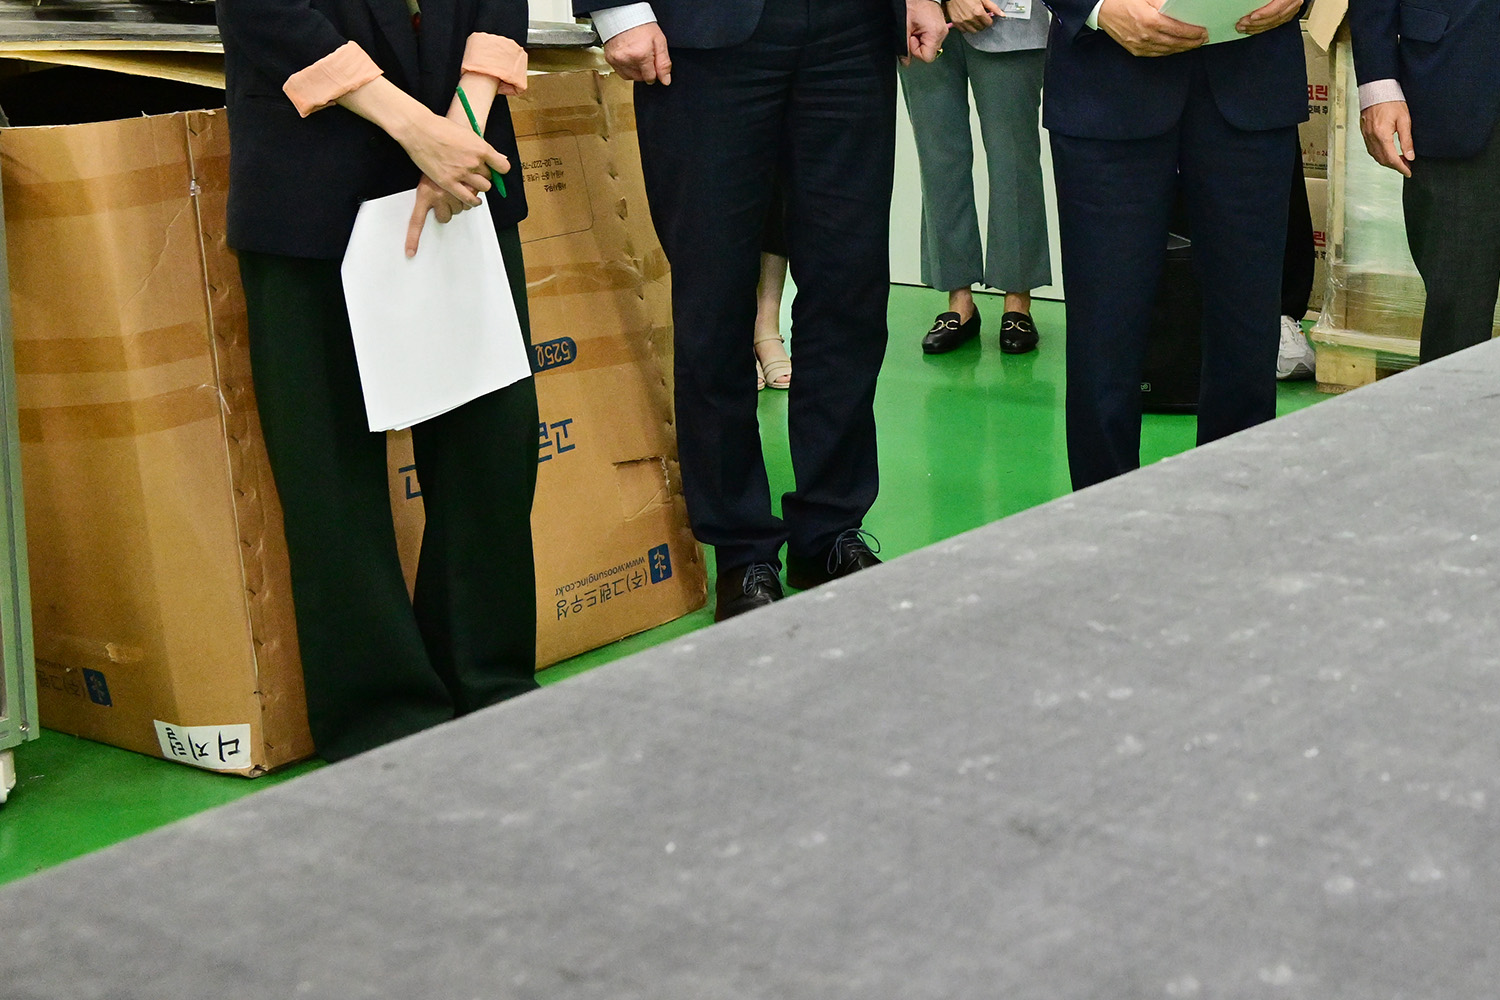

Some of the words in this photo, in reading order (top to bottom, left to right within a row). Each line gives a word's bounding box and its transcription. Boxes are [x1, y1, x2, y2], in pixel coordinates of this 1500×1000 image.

[555, 557, 645, 596] www.woosunginc.co.kr
[556, 568, 648, 620] (주)그랜드우성
[165, 727, 241, 763] 디지털
